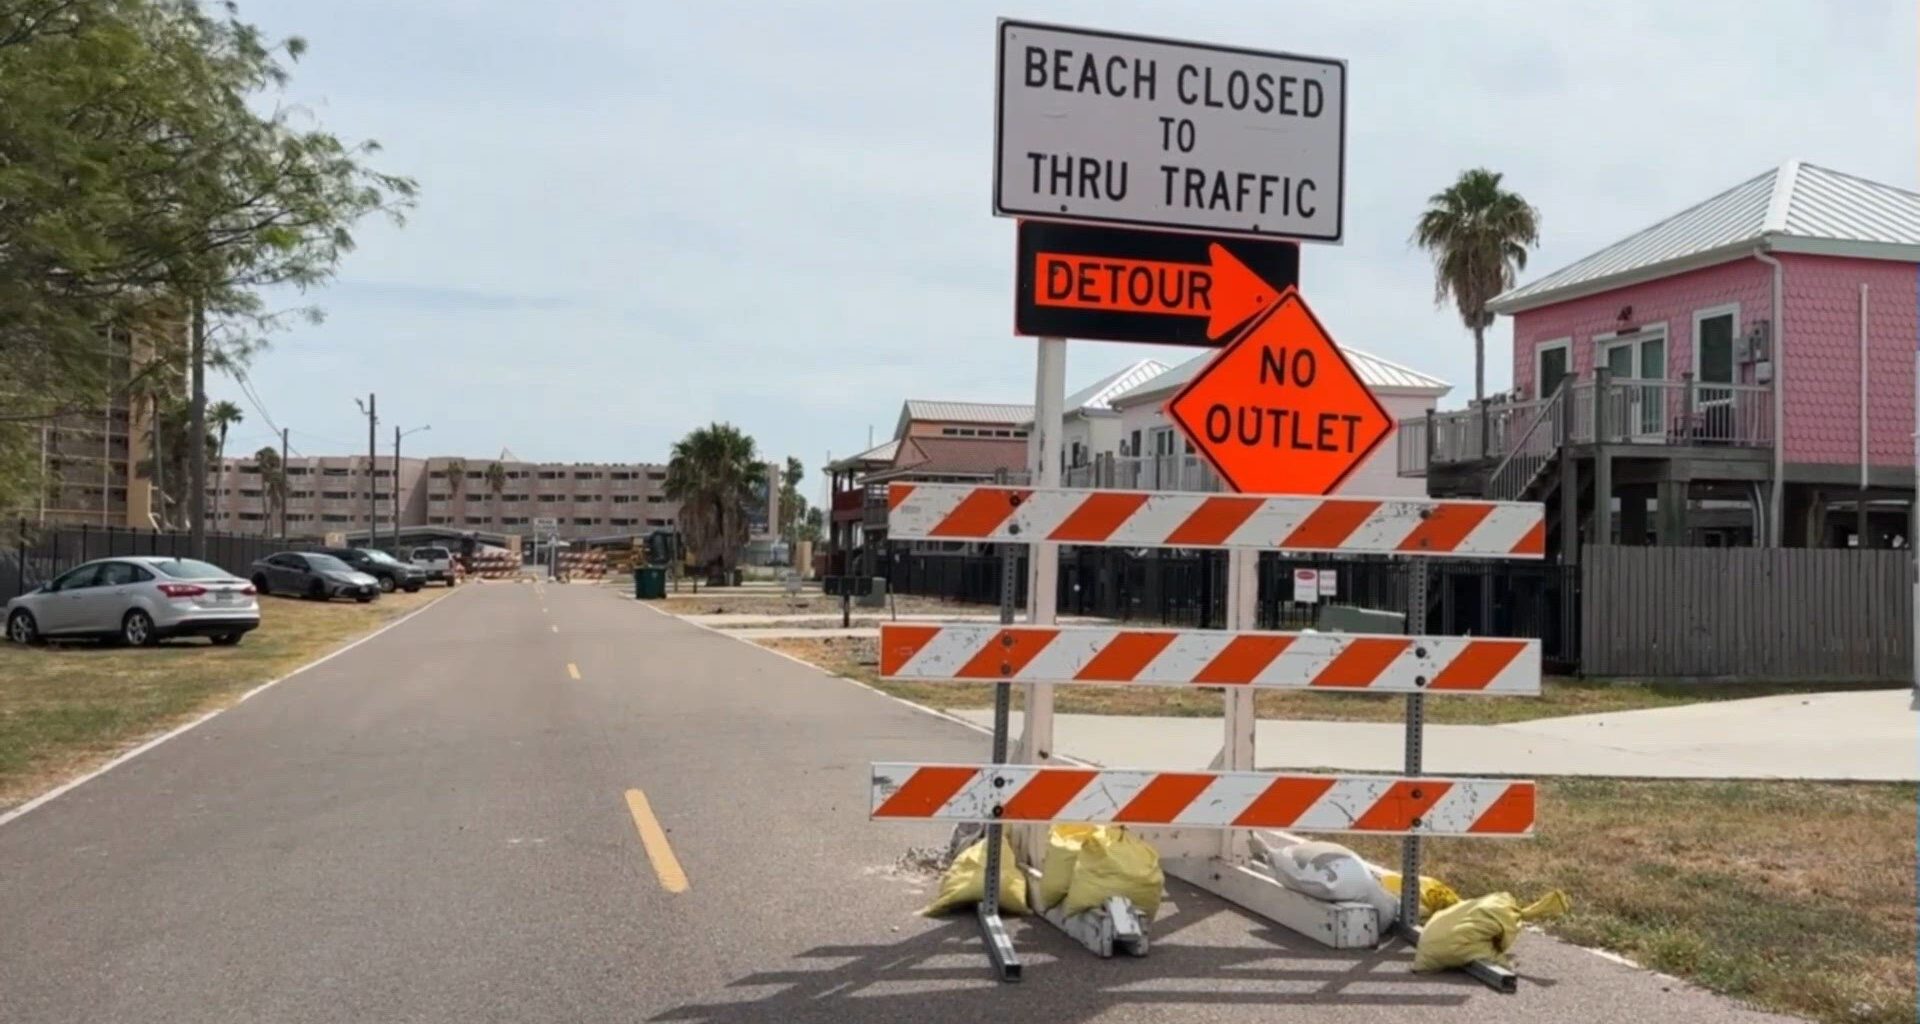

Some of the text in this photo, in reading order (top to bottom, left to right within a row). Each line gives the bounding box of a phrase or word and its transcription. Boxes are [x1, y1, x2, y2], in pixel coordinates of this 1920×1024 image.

[1025, 46, 1323, 118] BEACH CLOSED
[1159, 117, 1195, 153] TO
[1027, 152, 1316, 218] THRU TRAFFIC
[1047, 259, 1213, 310] DETOUR
[1260, 345, 1316, 388] NO
[1206, 404, 1362, 453] OUTLET
